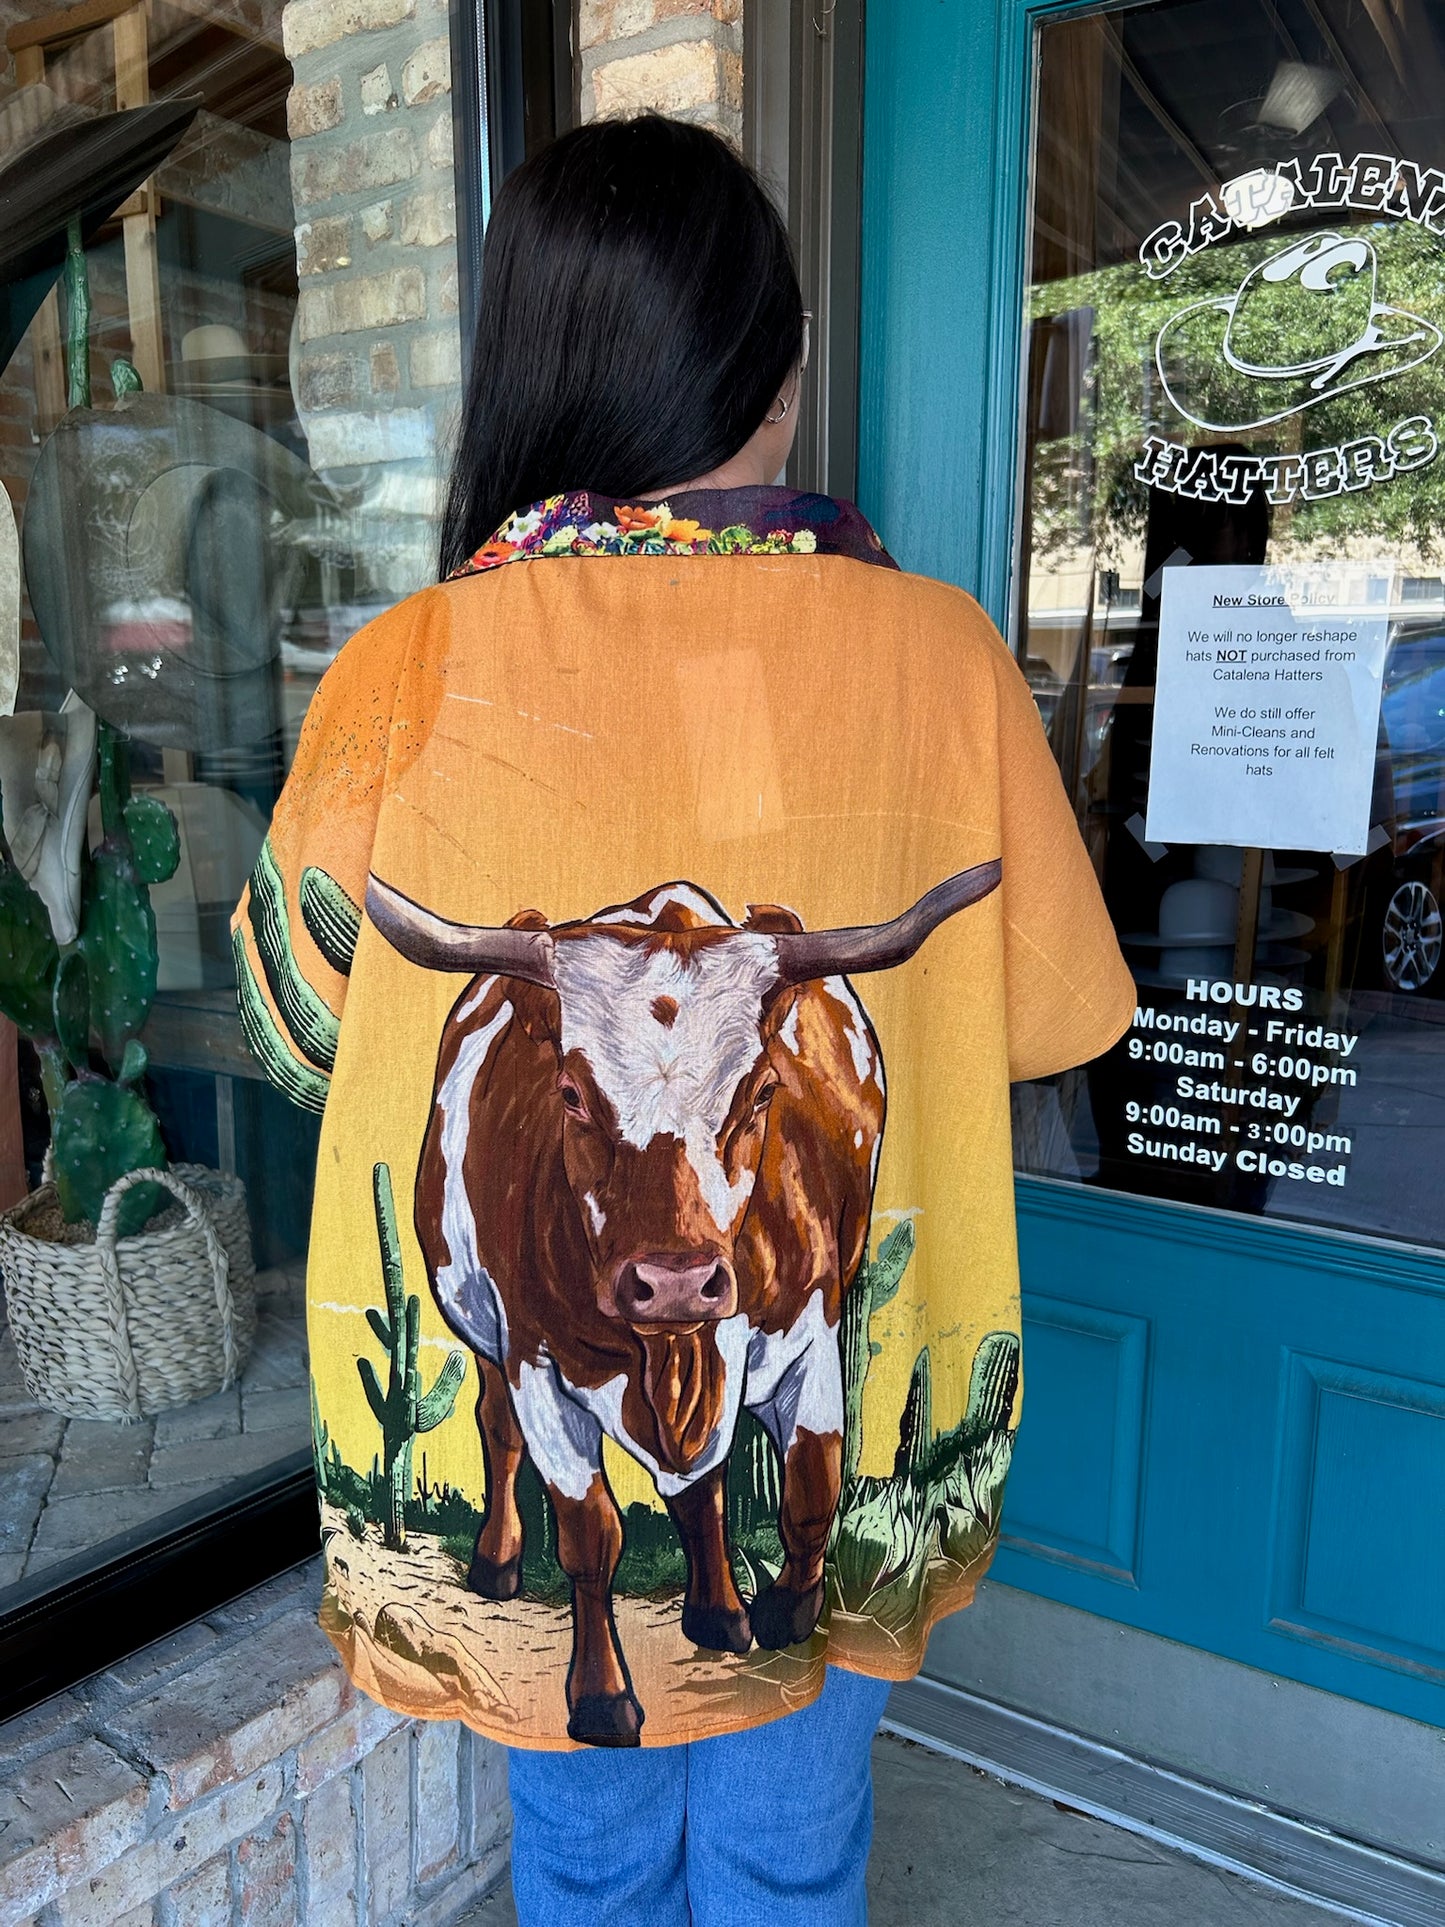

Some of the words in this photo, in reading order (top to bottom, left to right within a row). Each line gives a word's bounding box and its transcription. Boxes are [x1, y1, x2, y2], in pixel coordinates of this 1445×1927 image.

[1139, 152, 1445, 280] CATALEN
[1134, 416, 1438, 504] HATTERS
[1213, 595, 1243, 607] New
[1247, 594, 1285, 607] Store
[1188, 631, 1209, 643] We
[1213, 630, 1233, 643] will
[1237, 633, 1252, 643] no
[1257, 630, 1297, 646] longer
[1302, 629, 1357, 646] reshape
[1186, 649, 1212, 662] hats
[1216, 650, 1247, 662] NOT
[1251, 650, 1320, 666] purchased
[1325, 649, 1356, 661] from
[1213, 669, 1270, 681] Catalena
[1275, 669, 1323, 681] Hatters
[1215, 707, 1236, 719] We
[1240, 707, 1256, 719] do
[1261, 707, 1281, 719] still
[1286, 707, 1315, 720] offer
[1212, 725, 1286, 738] Mini-Cleans
[1291, 727, 1315, 739] and
[1191, 743, 1269, 758] Renovations
[1274, 745, 1292, 758] for
[1296, 746, 1310, 759] all
[1314, 746, 1335, 759] felt
[1246, 764, 1273, 777] hats
[1186, 979, 1303, 1010] HOURS
[1133, 1007, 1240, 1043] Monday
[1267, 1021, 1358, 1055] Friday
[1128, 1038, 1225, 1069] 9:00am
[1252, 1053, 1357, 1086] 6:00pm
[1176, 1076, 1301, 1117] Saturday
[1125, 1101, 1220, 1135] 9:00am
[1248, 1122, 1352, 1154] 3:00pm
[1127, 1133, 1227, 1171] Sunday
[1236, 1150, 1346, 1187] Closed
